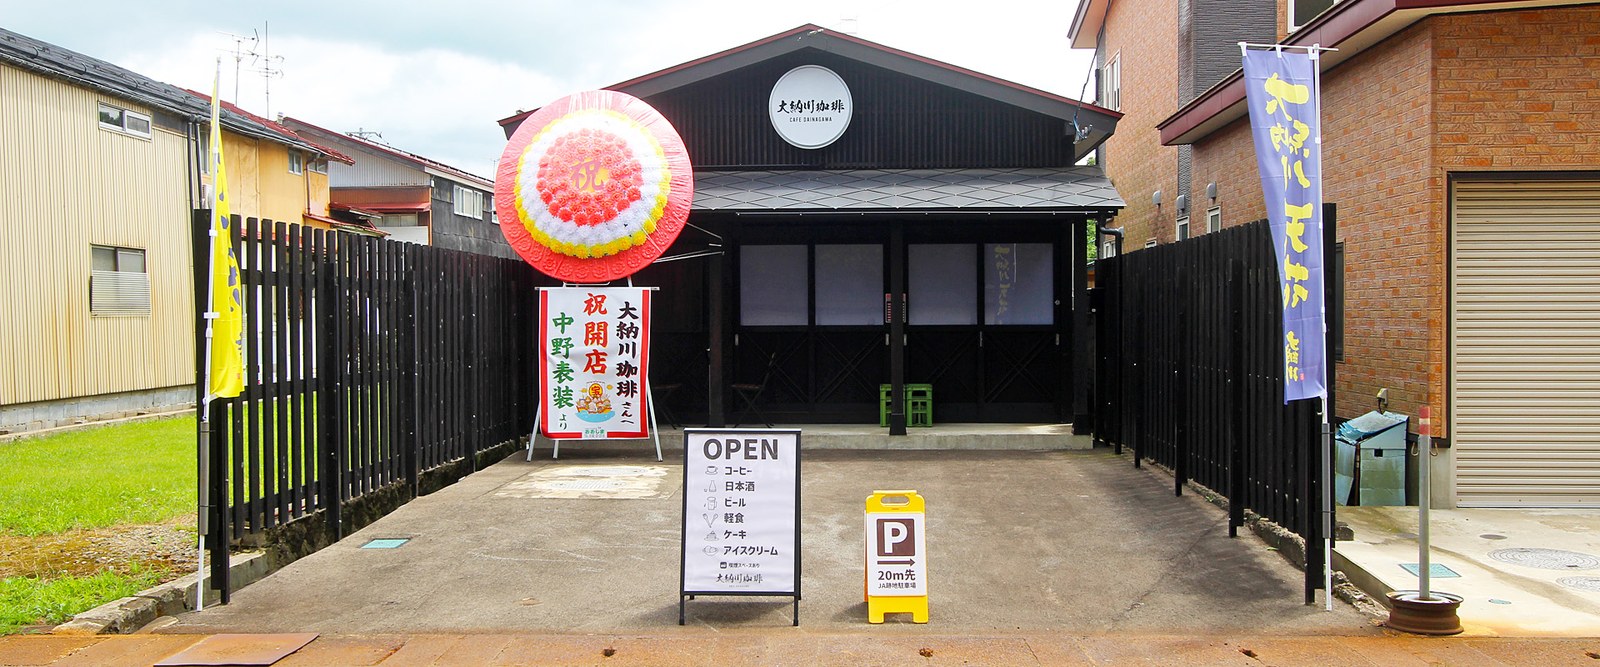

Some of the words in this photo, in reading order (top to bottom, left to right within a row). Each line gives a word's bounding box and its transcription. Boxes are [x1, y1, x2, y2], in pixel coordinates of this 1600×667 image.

[777, 99, 844, 114] 大納川珈琲
[570, 158, 604, 191] 祝
[703, 438, 779, 460] OPEN
[724, 466, 752, 476] コーヒー
[725, 481, 755, 492] 日本酒
[724, 497, 746, 508] ビール
[723, 513, 744, 524] 軽食
[723, 529, 746, 539] ケーキ
[883, 521, 908, 554] P
[723, 546, 778, 556] アイスクリーム
[716, 573, 763, 584] 大納川珈琲
[878, 569, 916, 581] 20m先
